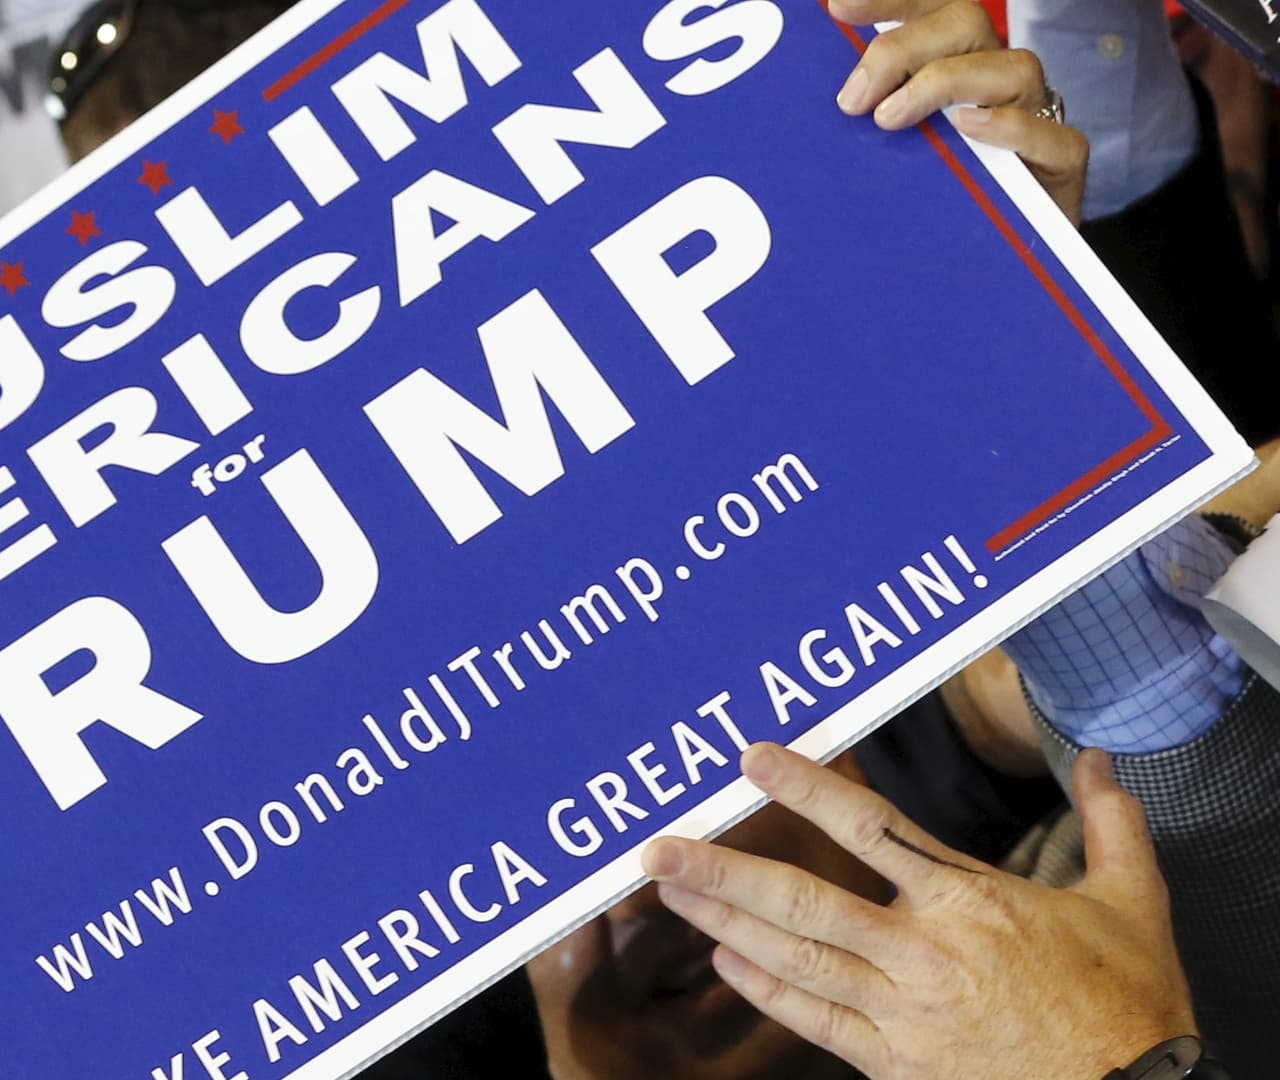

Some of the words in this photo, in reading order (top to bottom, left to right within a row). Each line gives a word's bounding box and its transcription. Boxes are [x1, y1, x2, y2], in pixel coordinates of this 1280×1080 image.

[35, 453, 819, 992] www.DonaldJTrump.com
[190, 434, 265, 497] for
[252, 841, 548, 1063] AMERICA
[547, 690, 752, 857] GREAT
[759, 534, 988, 725] AGAIN!
